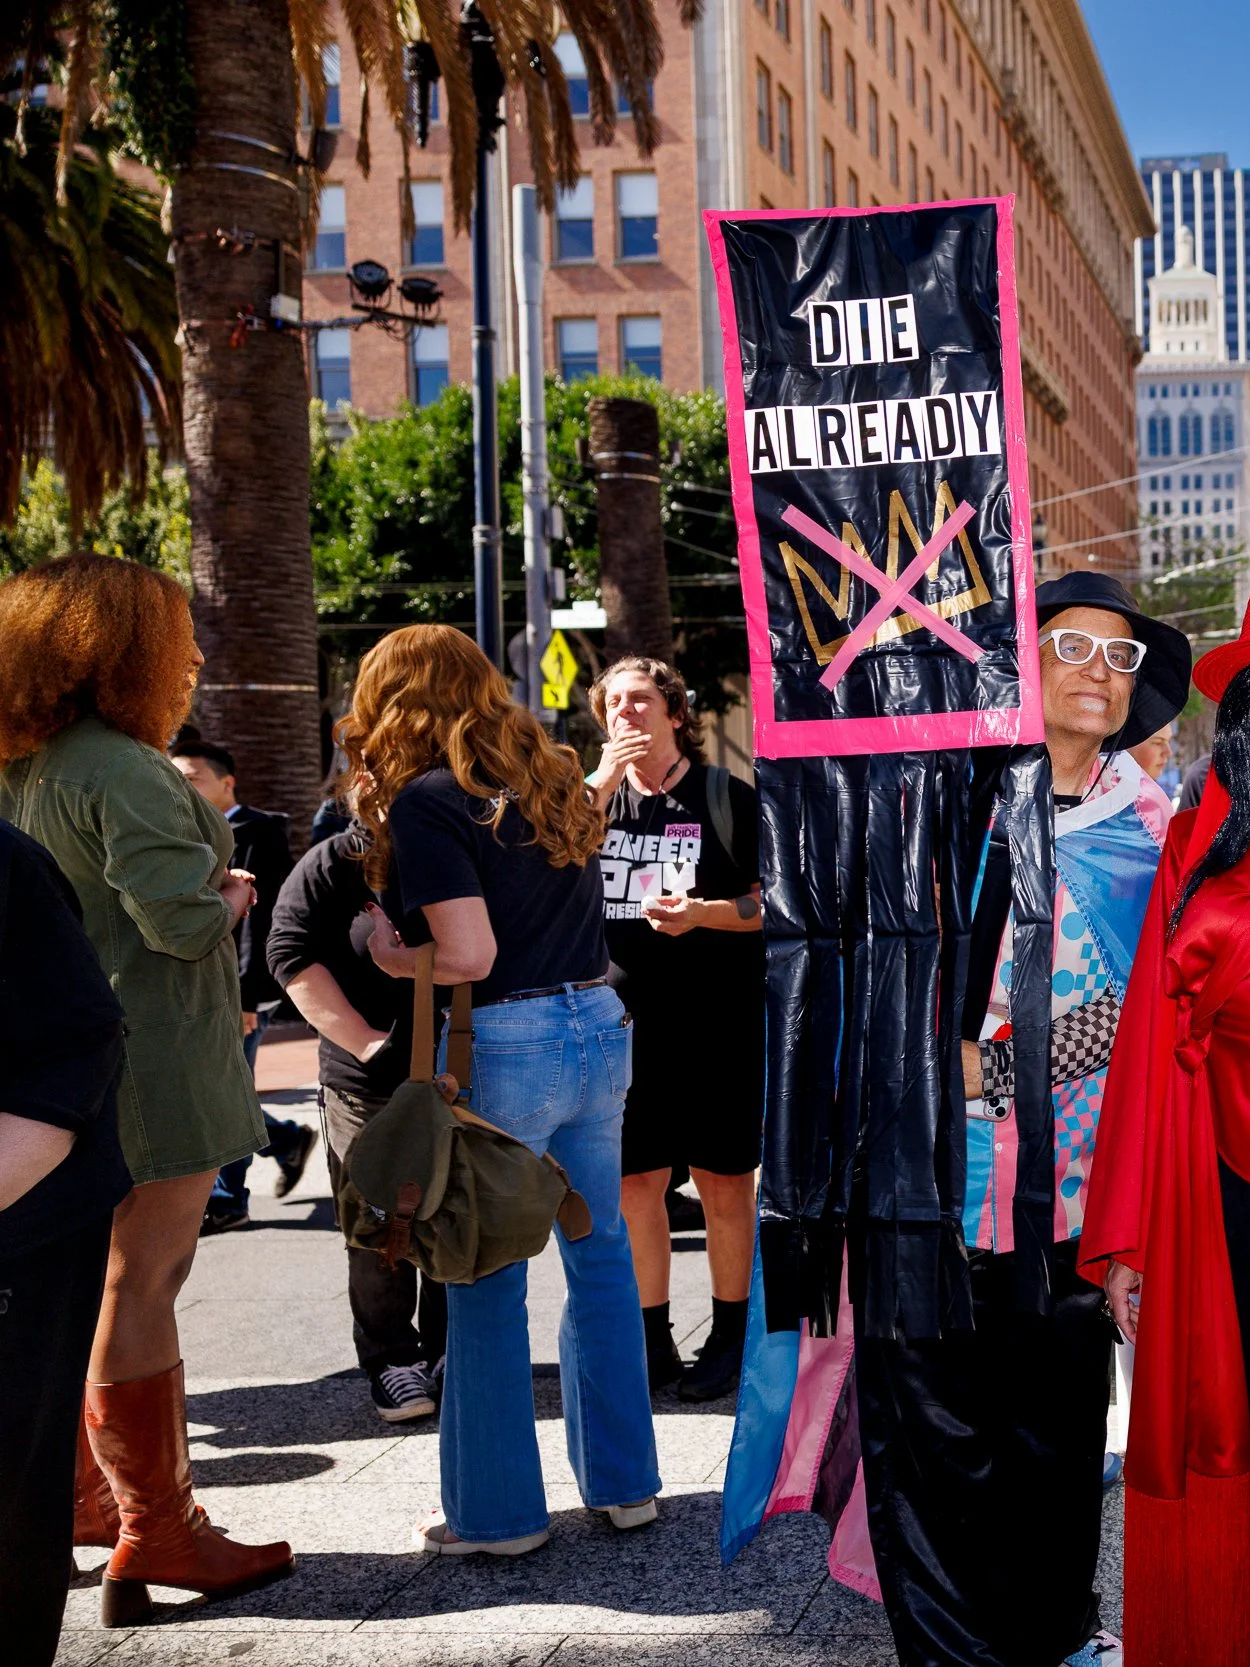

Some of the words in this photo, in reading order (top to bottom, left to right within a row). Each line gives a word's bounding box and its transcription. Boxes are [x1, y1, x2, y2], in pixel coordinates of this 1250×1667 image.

[813, 297, 913, 364] DIE
[751, 393, 993, 472] ALREADY
[600, 828, 702, 865] QUEER
[667, 829, 700, 838] PRIDE
